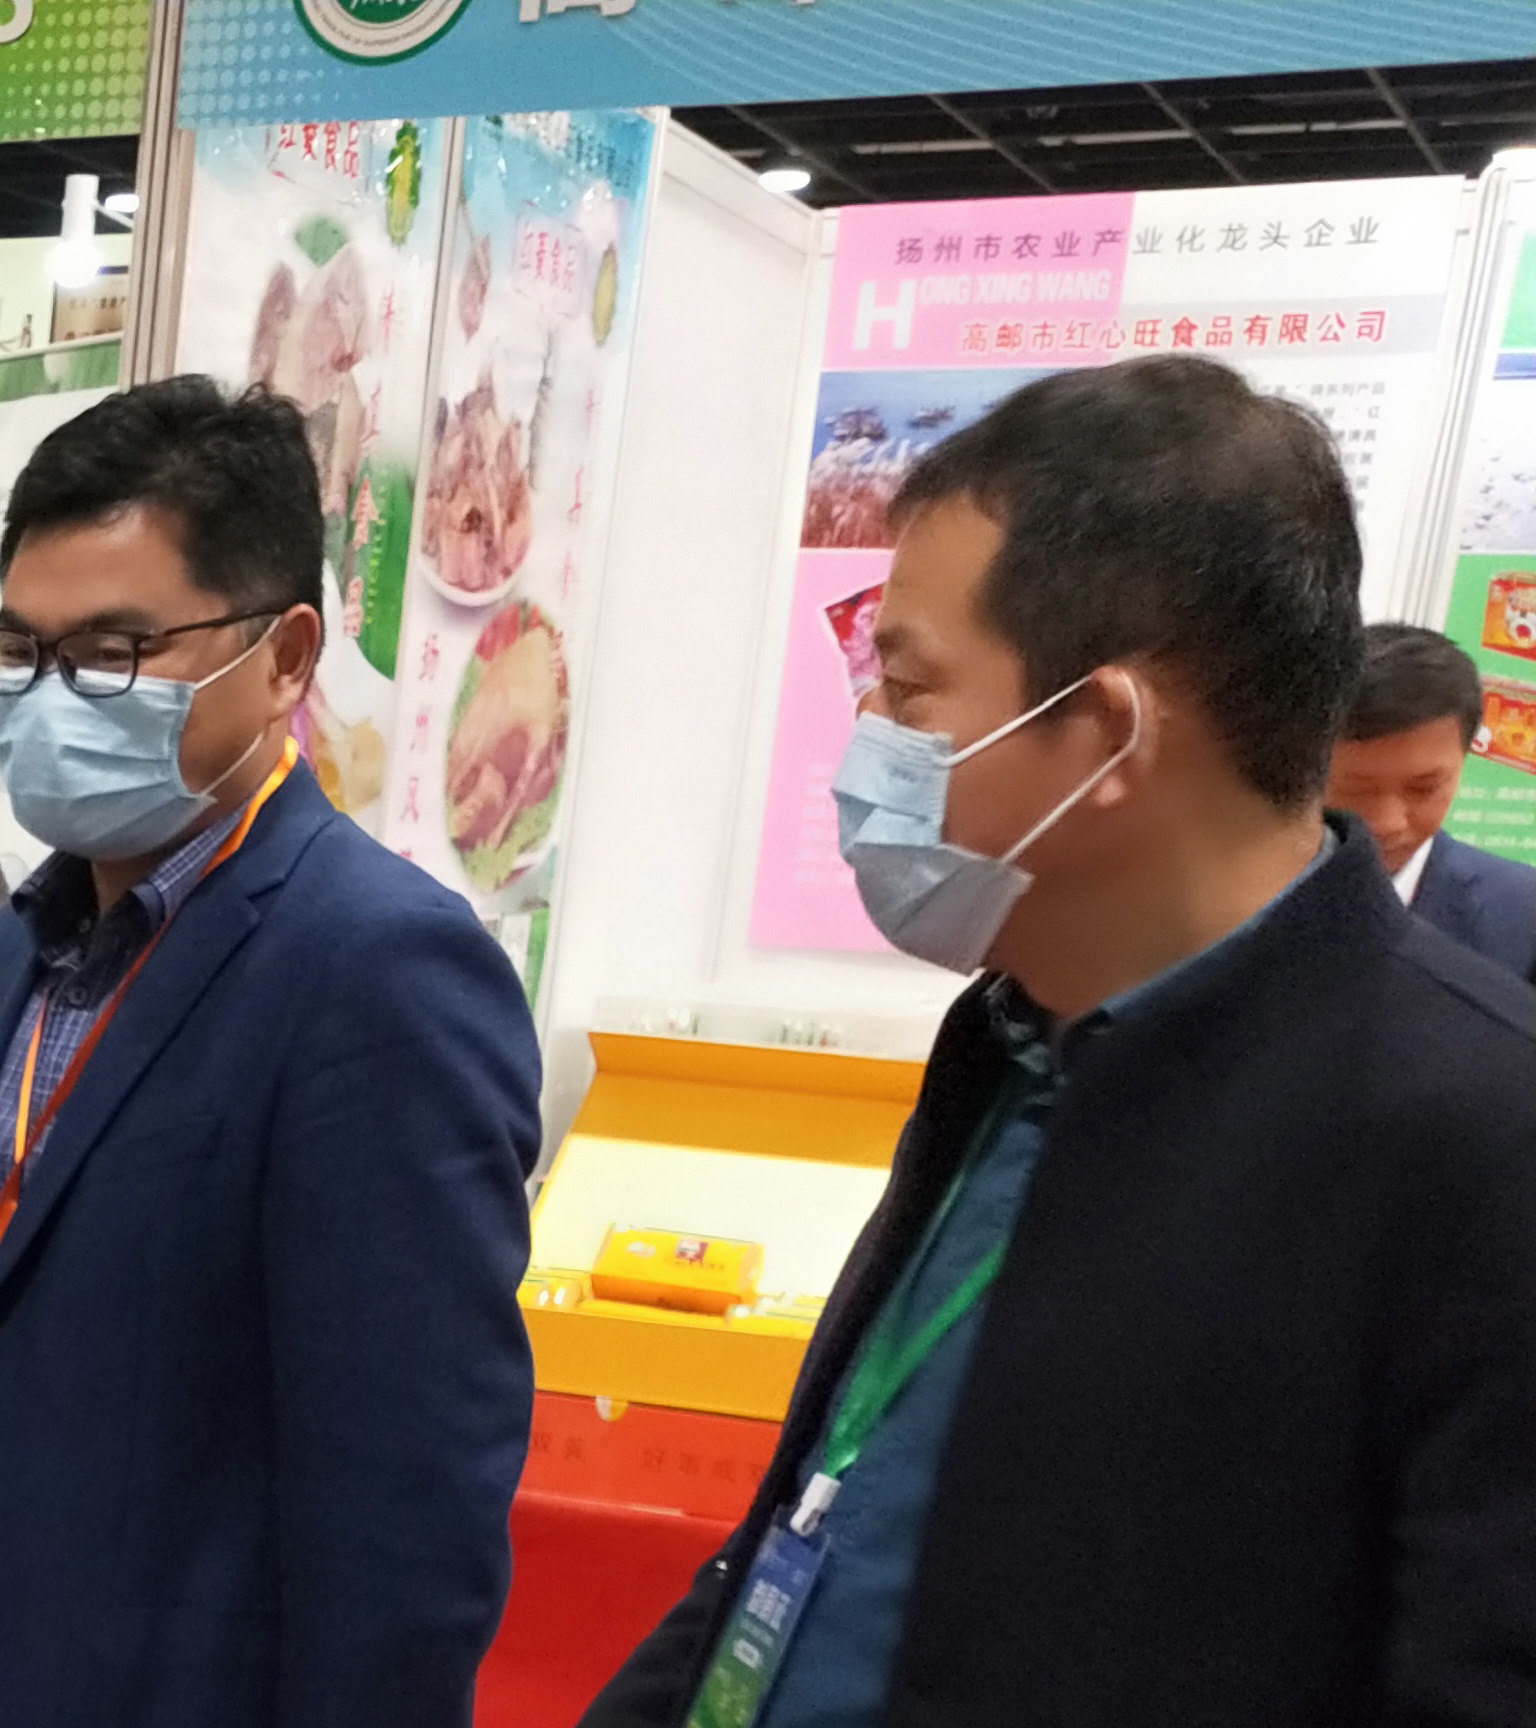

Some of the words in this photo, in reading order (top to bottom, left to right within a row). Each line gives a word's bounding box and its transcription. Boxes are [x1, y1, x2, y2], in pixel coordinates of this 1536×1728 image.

[894, 215, 1380, 265] 扬州市农业产业化龙头企业
[1036, 268, 1112, 303] WANG
[961, 309, 1387, 353] 高邮市红心旺食品有限公司
